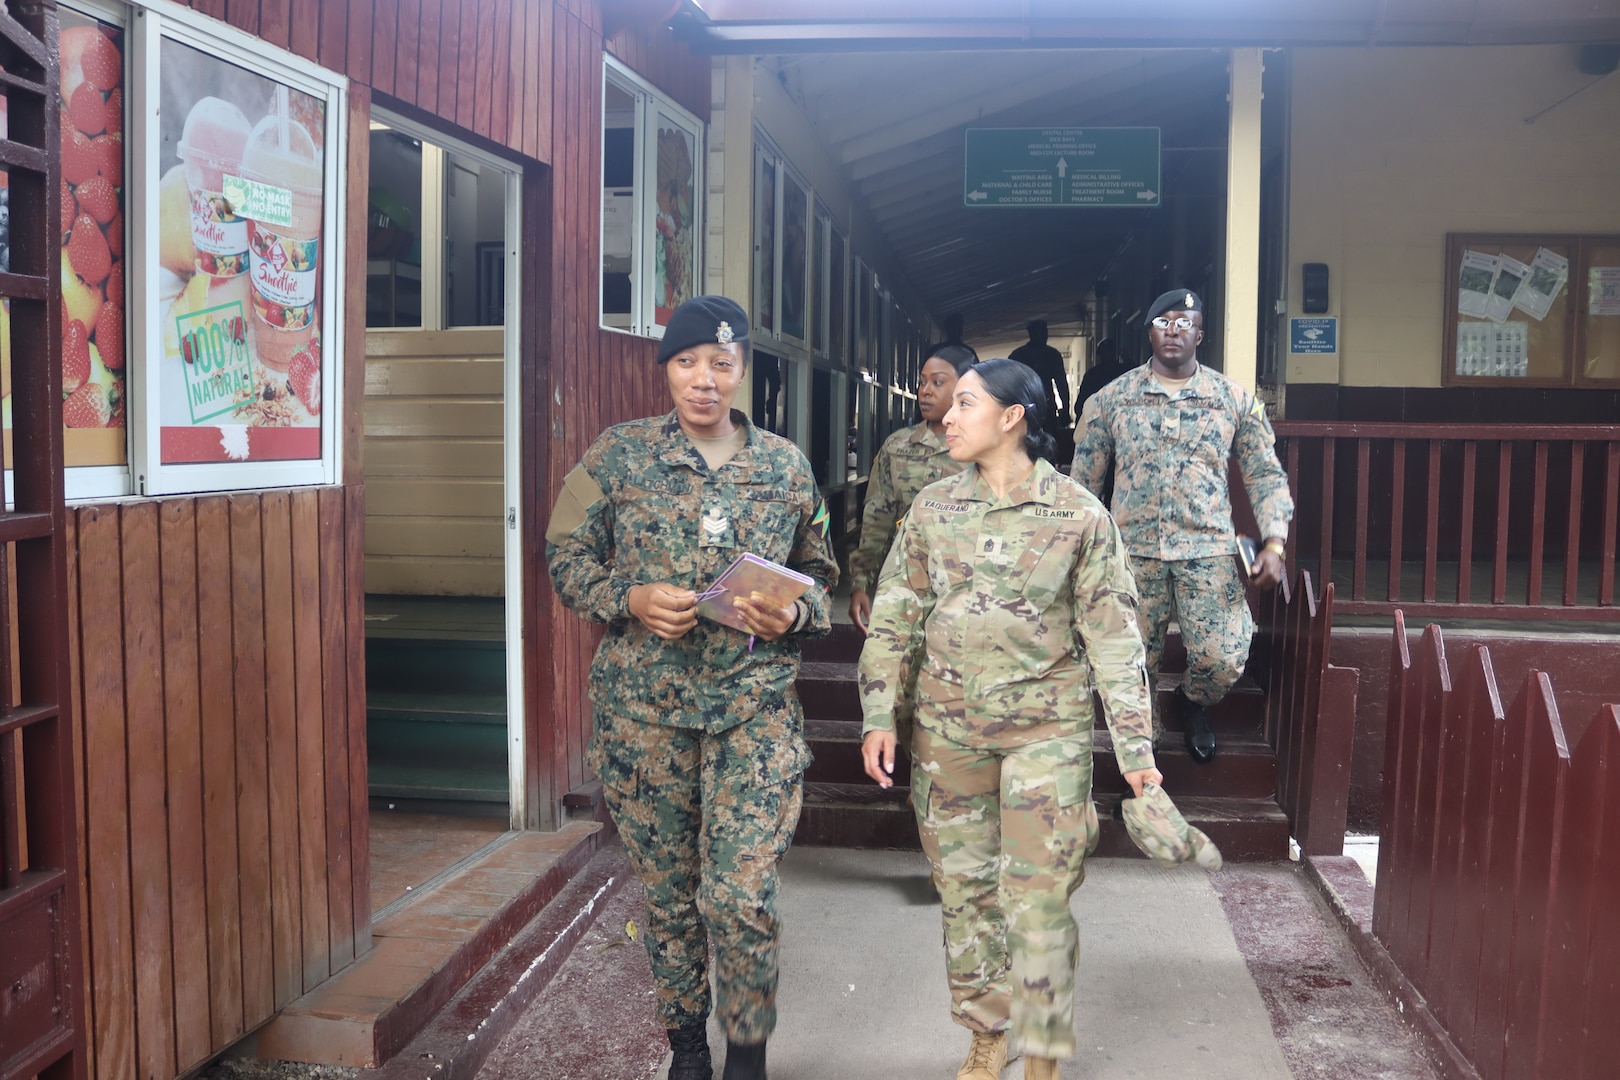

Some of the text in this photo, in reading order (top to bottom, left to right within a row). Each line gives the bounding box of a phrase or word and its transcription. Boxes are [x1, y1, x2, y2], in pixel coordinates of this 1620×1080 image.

[252, 187, 290, 206] NO MASK
[252, 200, 291, 218] NO ENTRY
[258, 262, 298, 295] Smoothie
[186, 315, 243, 377] 100%
[192, 367, 249, 406] NATURAL
[924, 500, 969, 513] VAQUERANO
